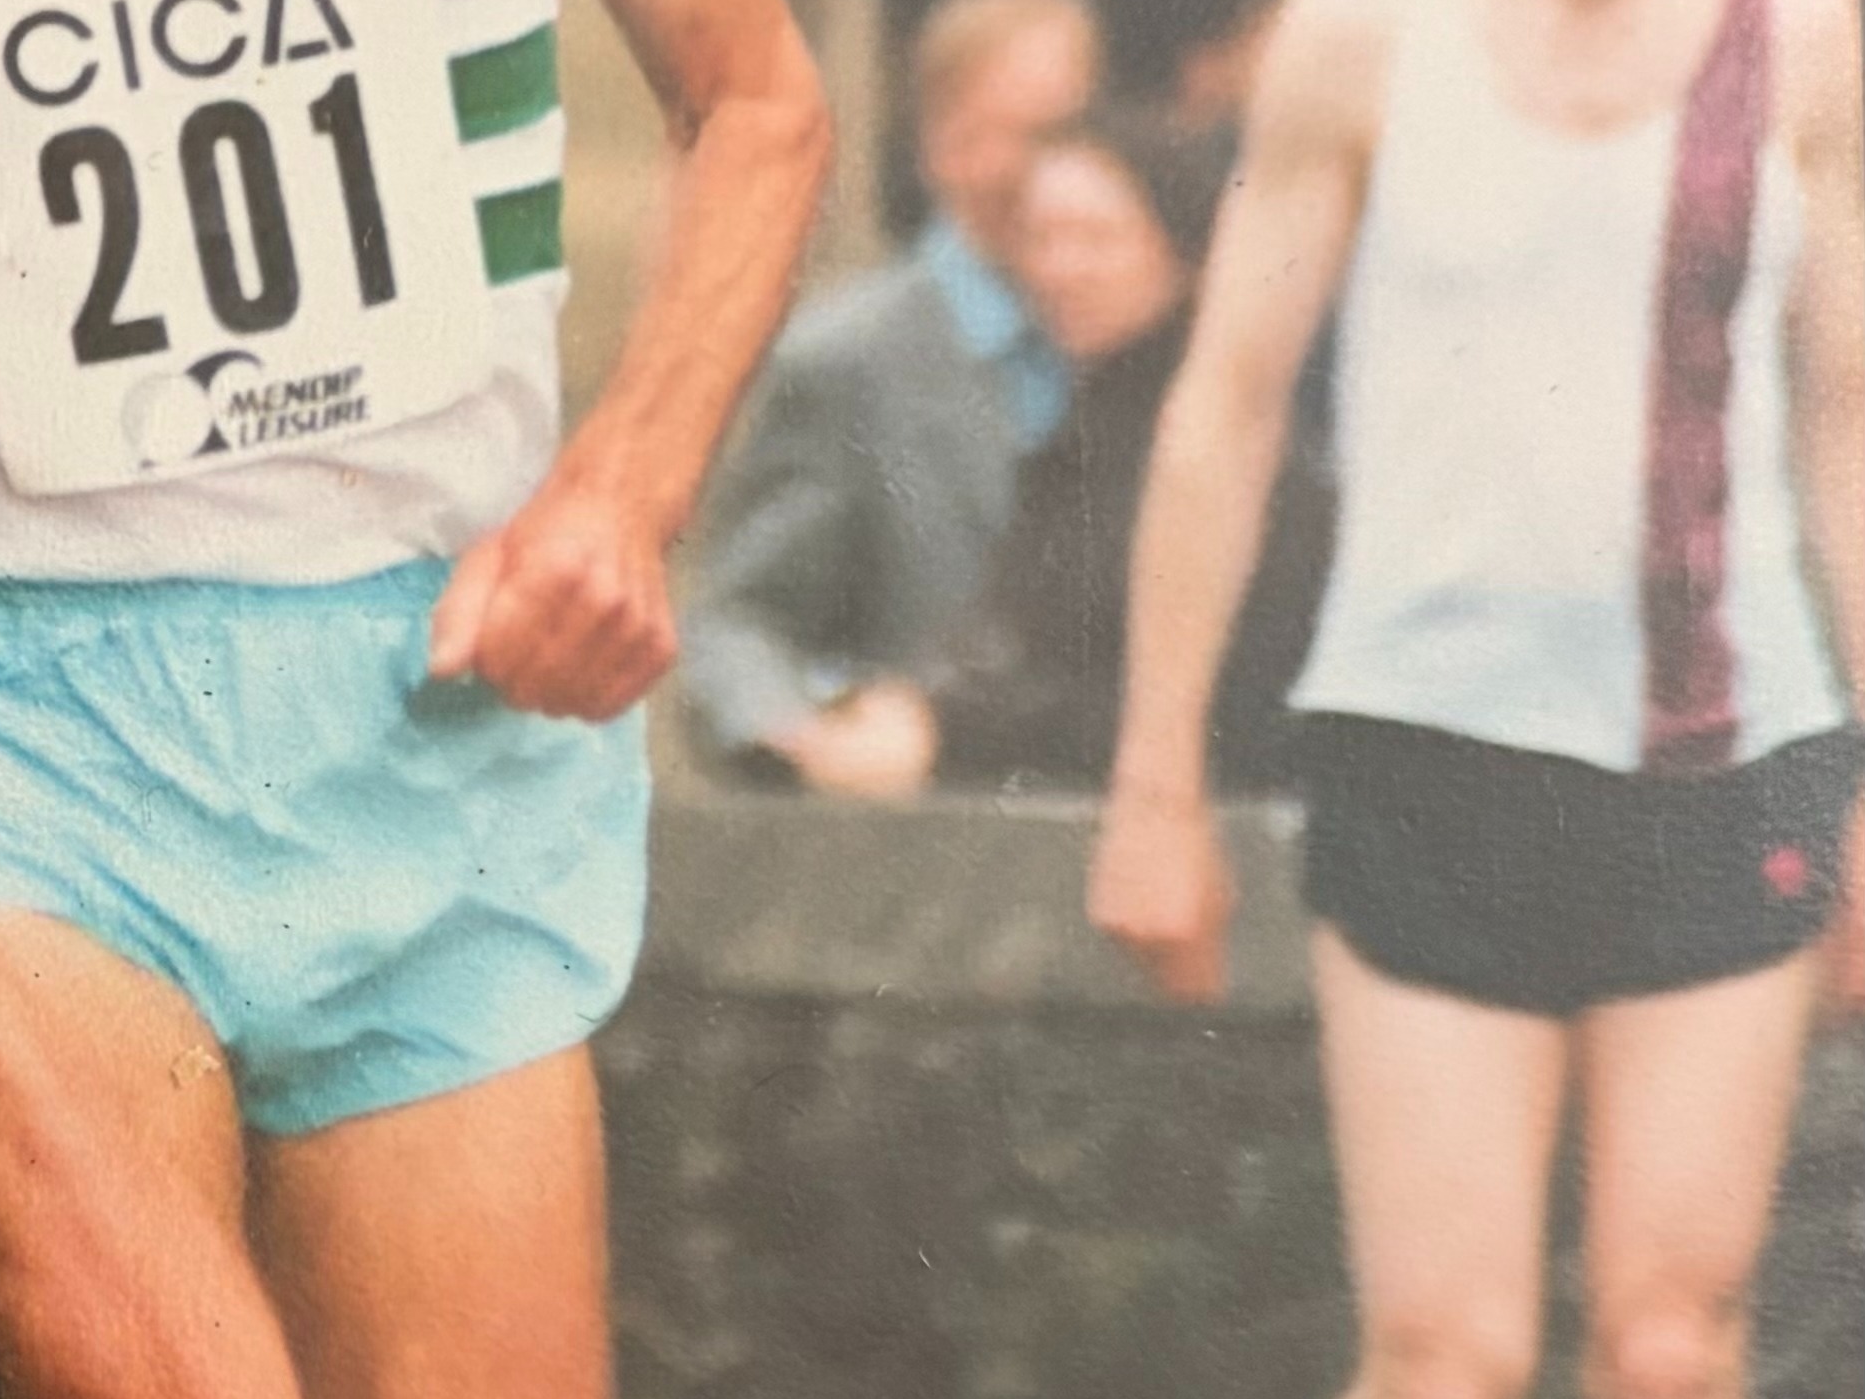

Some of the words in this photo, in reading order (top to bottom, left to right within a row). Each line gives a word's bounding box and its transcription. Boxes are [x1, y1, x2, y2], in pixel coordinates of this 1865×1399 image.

[38, 72, 396, 366] 201
[227, 365, 363, 417] MENDIP
[238, 395, 369, 447] LEISURE
